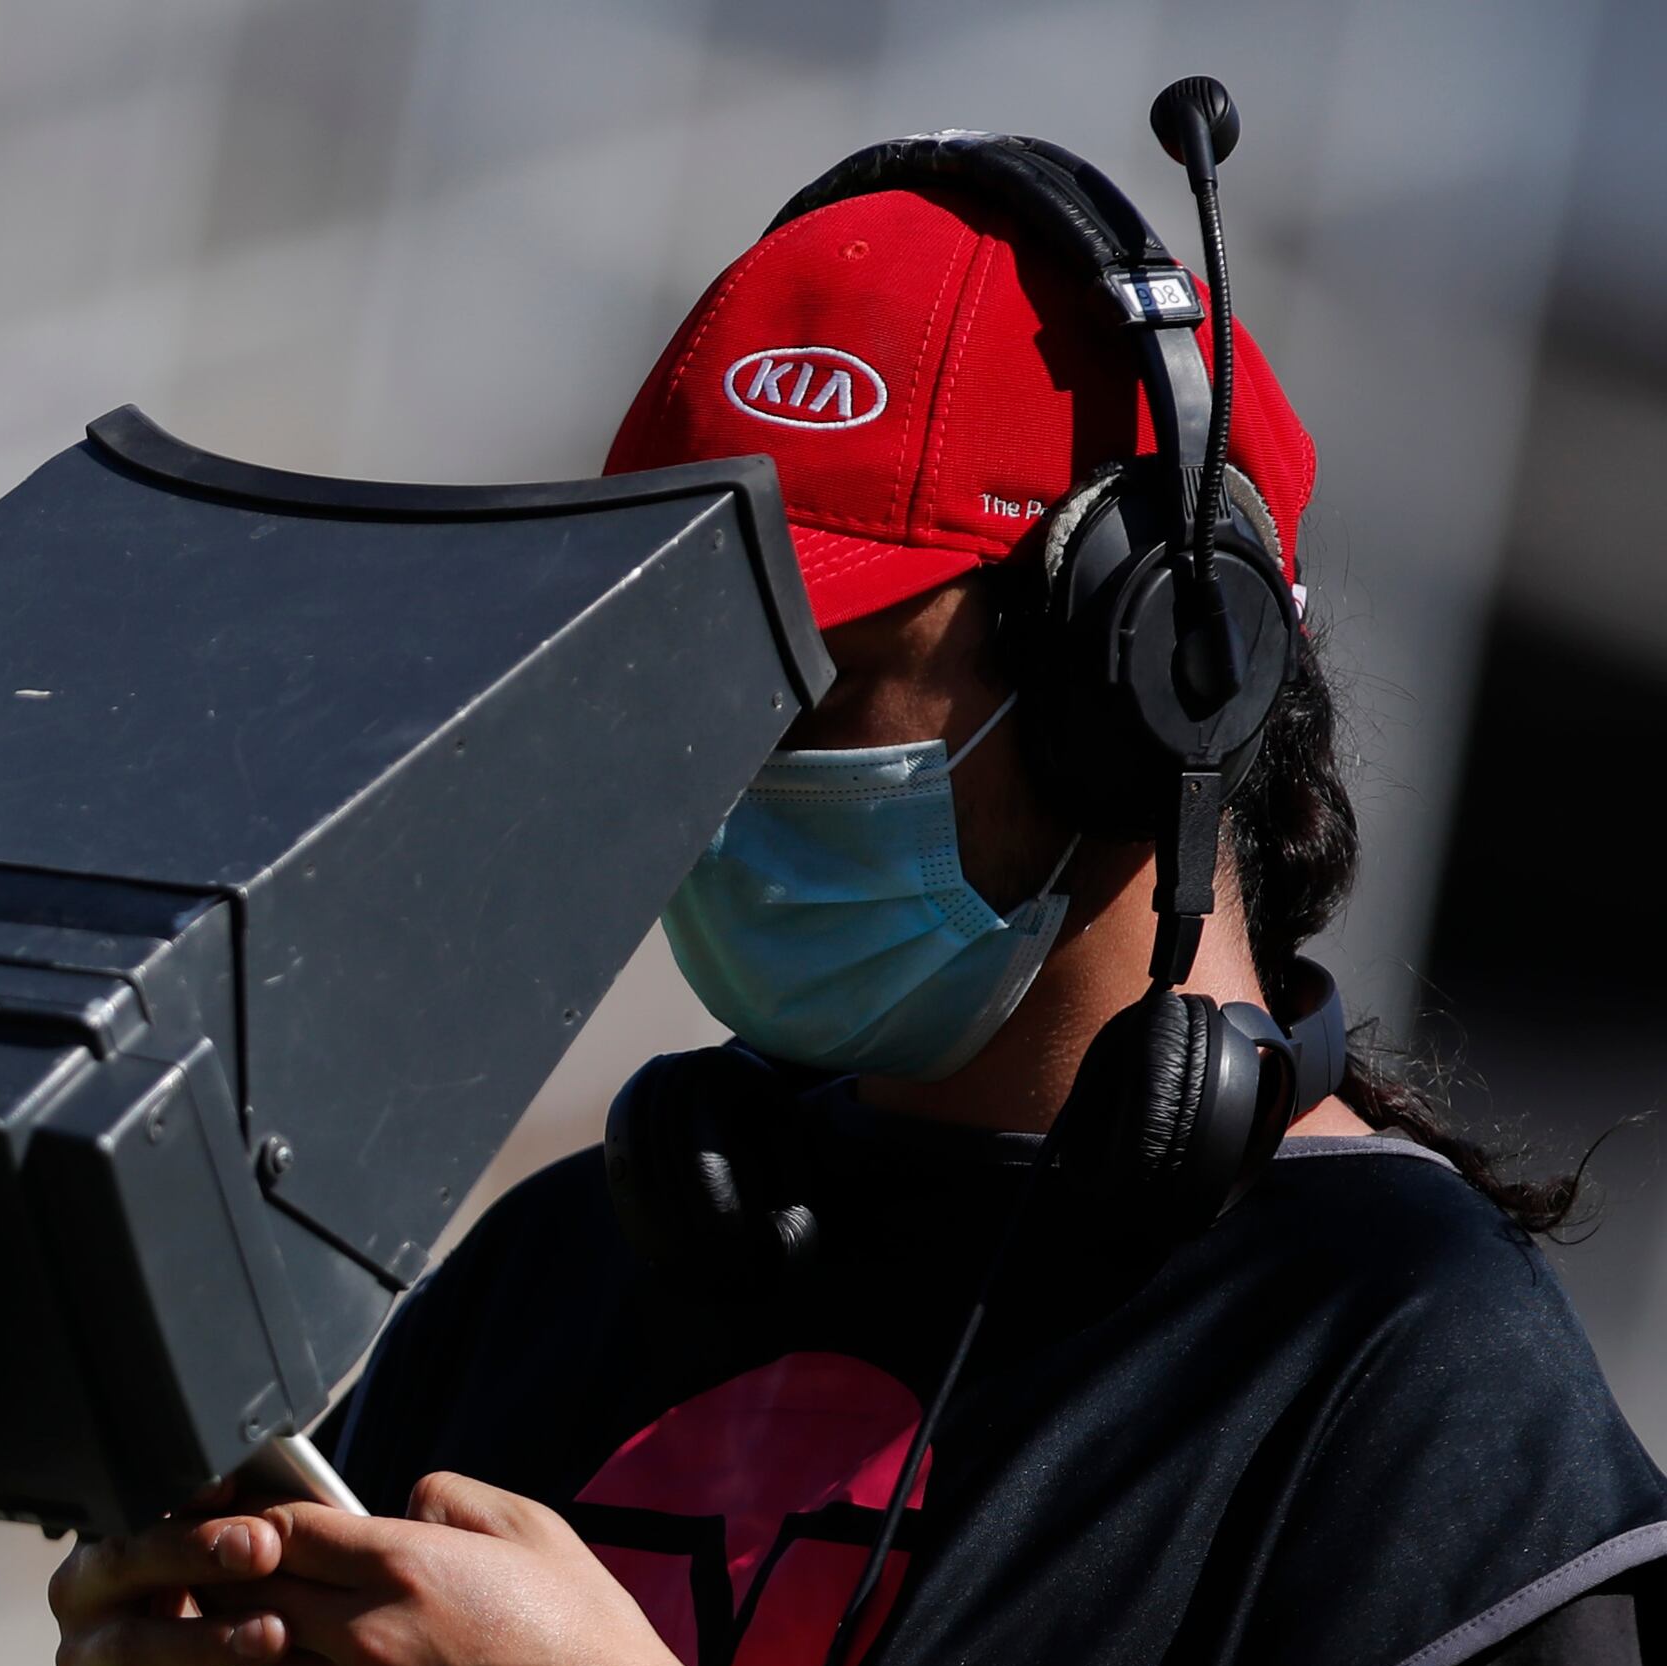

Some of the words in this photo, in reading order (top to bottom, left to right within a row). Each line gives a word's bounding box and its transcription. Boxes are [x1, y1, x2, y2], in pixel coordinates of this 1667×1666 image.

[1136, 282, 1183, 308] 908
[746, 358, 853, 418] KIA
[978, 493, 1021, 519] The
